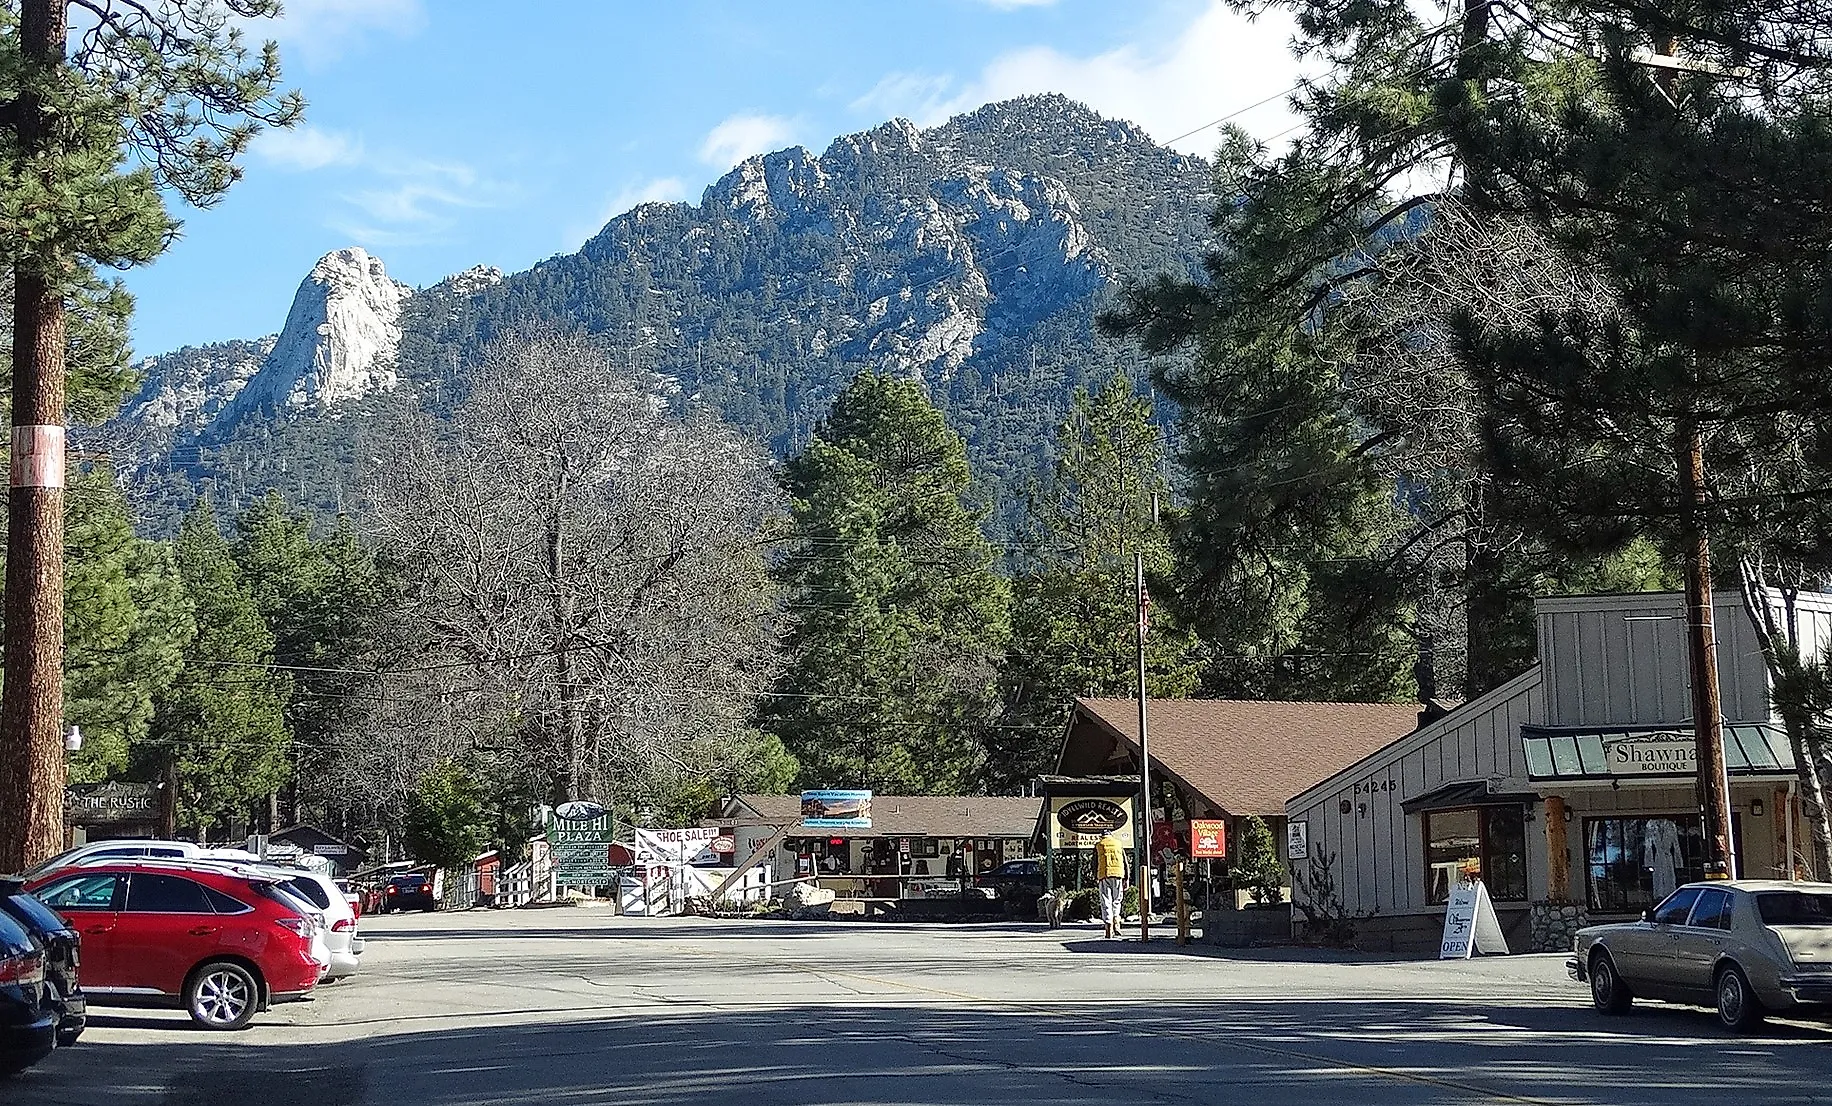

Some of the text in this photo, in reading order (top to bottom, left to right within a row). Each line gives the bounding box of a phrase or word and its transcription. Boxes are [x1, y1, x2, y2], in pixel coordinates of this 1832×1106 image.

[1642, 762, 1687, 771] BOUTIQUE
[1354, 780, 1397, 795] 54245
[84, 796, 152, 809] THE RUSTIC
[1061, 801, 1123, 818] IDYLLWILD REALTY
[552, 814, 608, 831] MILE HI
[1192, 820, 1223, 830] Oakwood
[558, 831, 602, 841] PLAZA
[656, 829, 717, 843] SHOE SALE!!!
[1197, 829, 1219, 838] Village
[1442, 941, 1469, 951] OPEN
